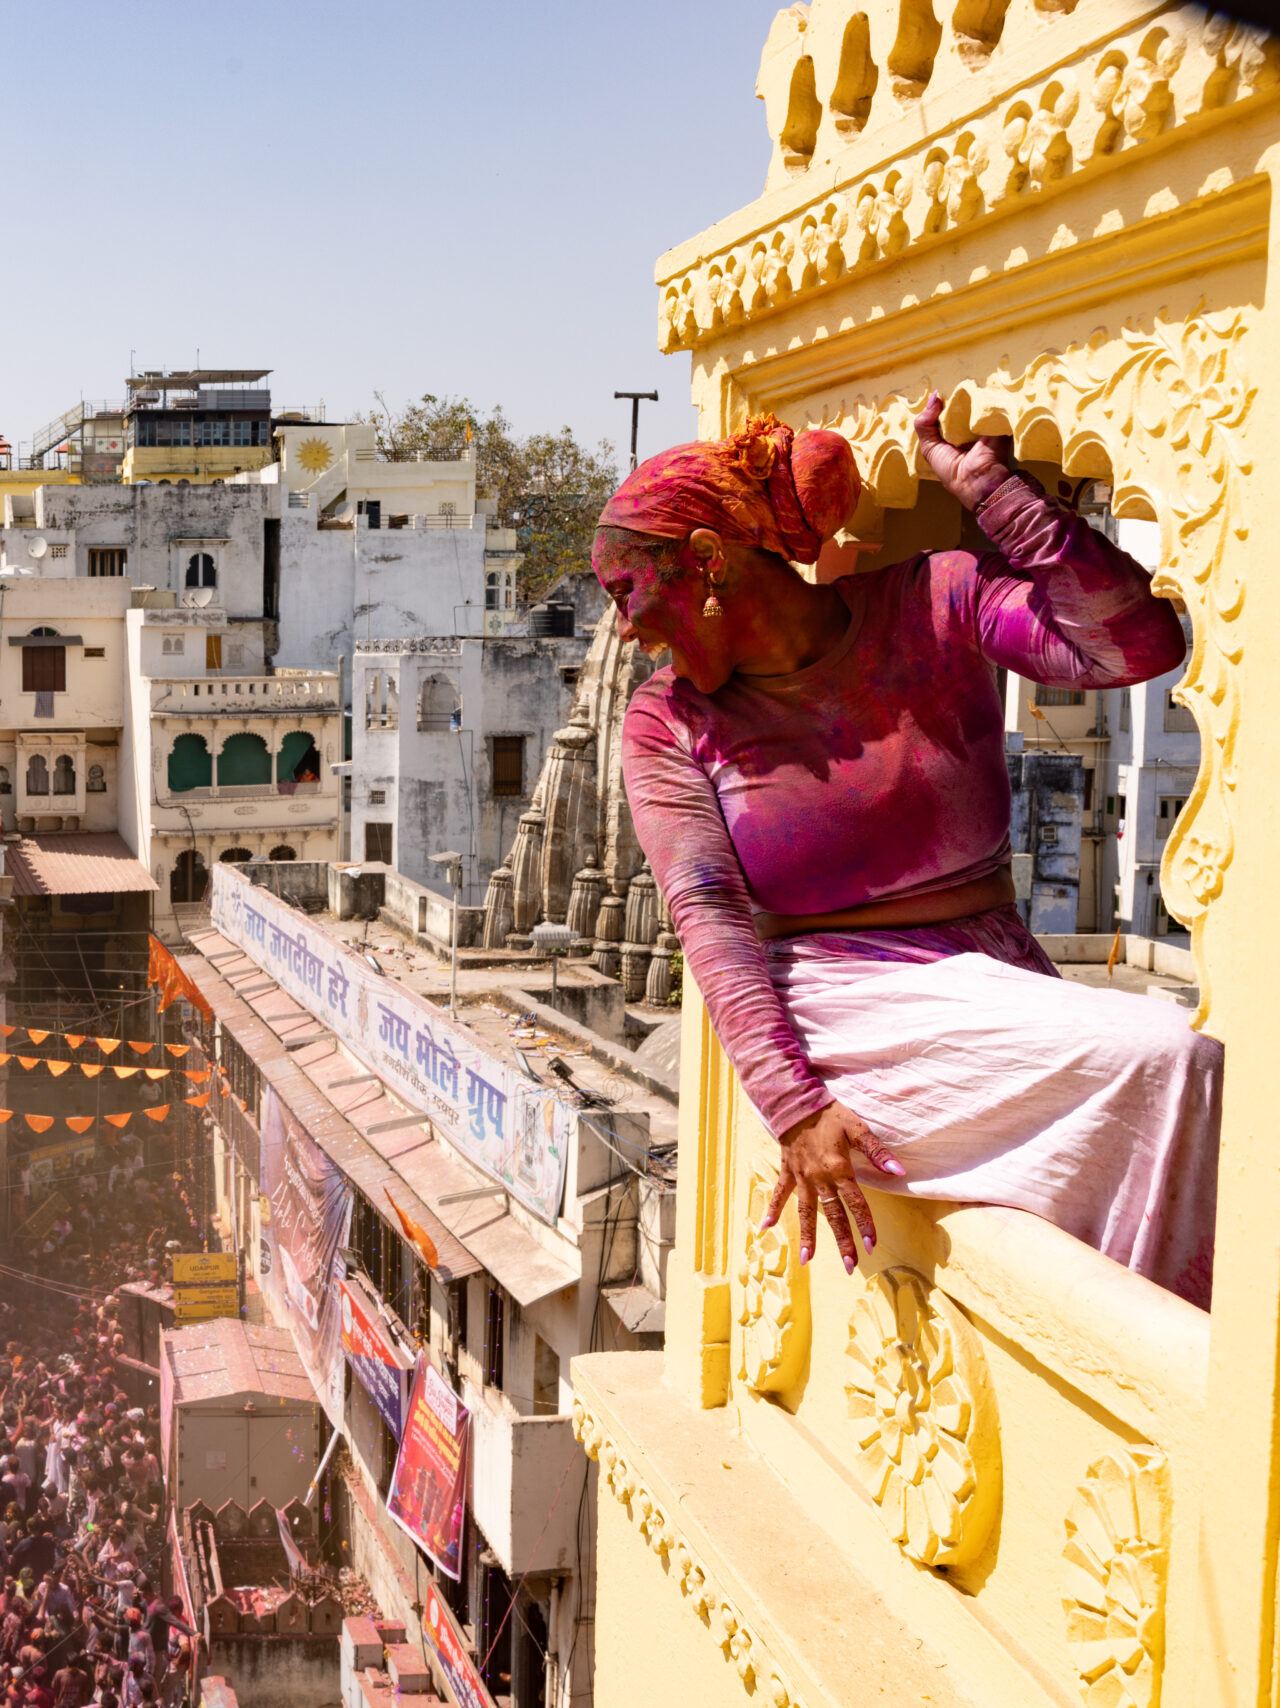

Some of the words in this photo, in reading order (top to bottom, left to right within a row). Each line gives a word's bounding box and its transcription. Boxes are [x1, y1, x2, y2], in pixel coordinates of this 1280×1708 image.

[243, 902, 267, 950] जय
[268, 921, 325, 998] जगदीश
[327, 960, 350, 1018] हरे
[377, 1001, 411, 1061] जय
[416, 1023, 461, 1103] भोले
[432, 1092, 460, 1126] उदयपुर
